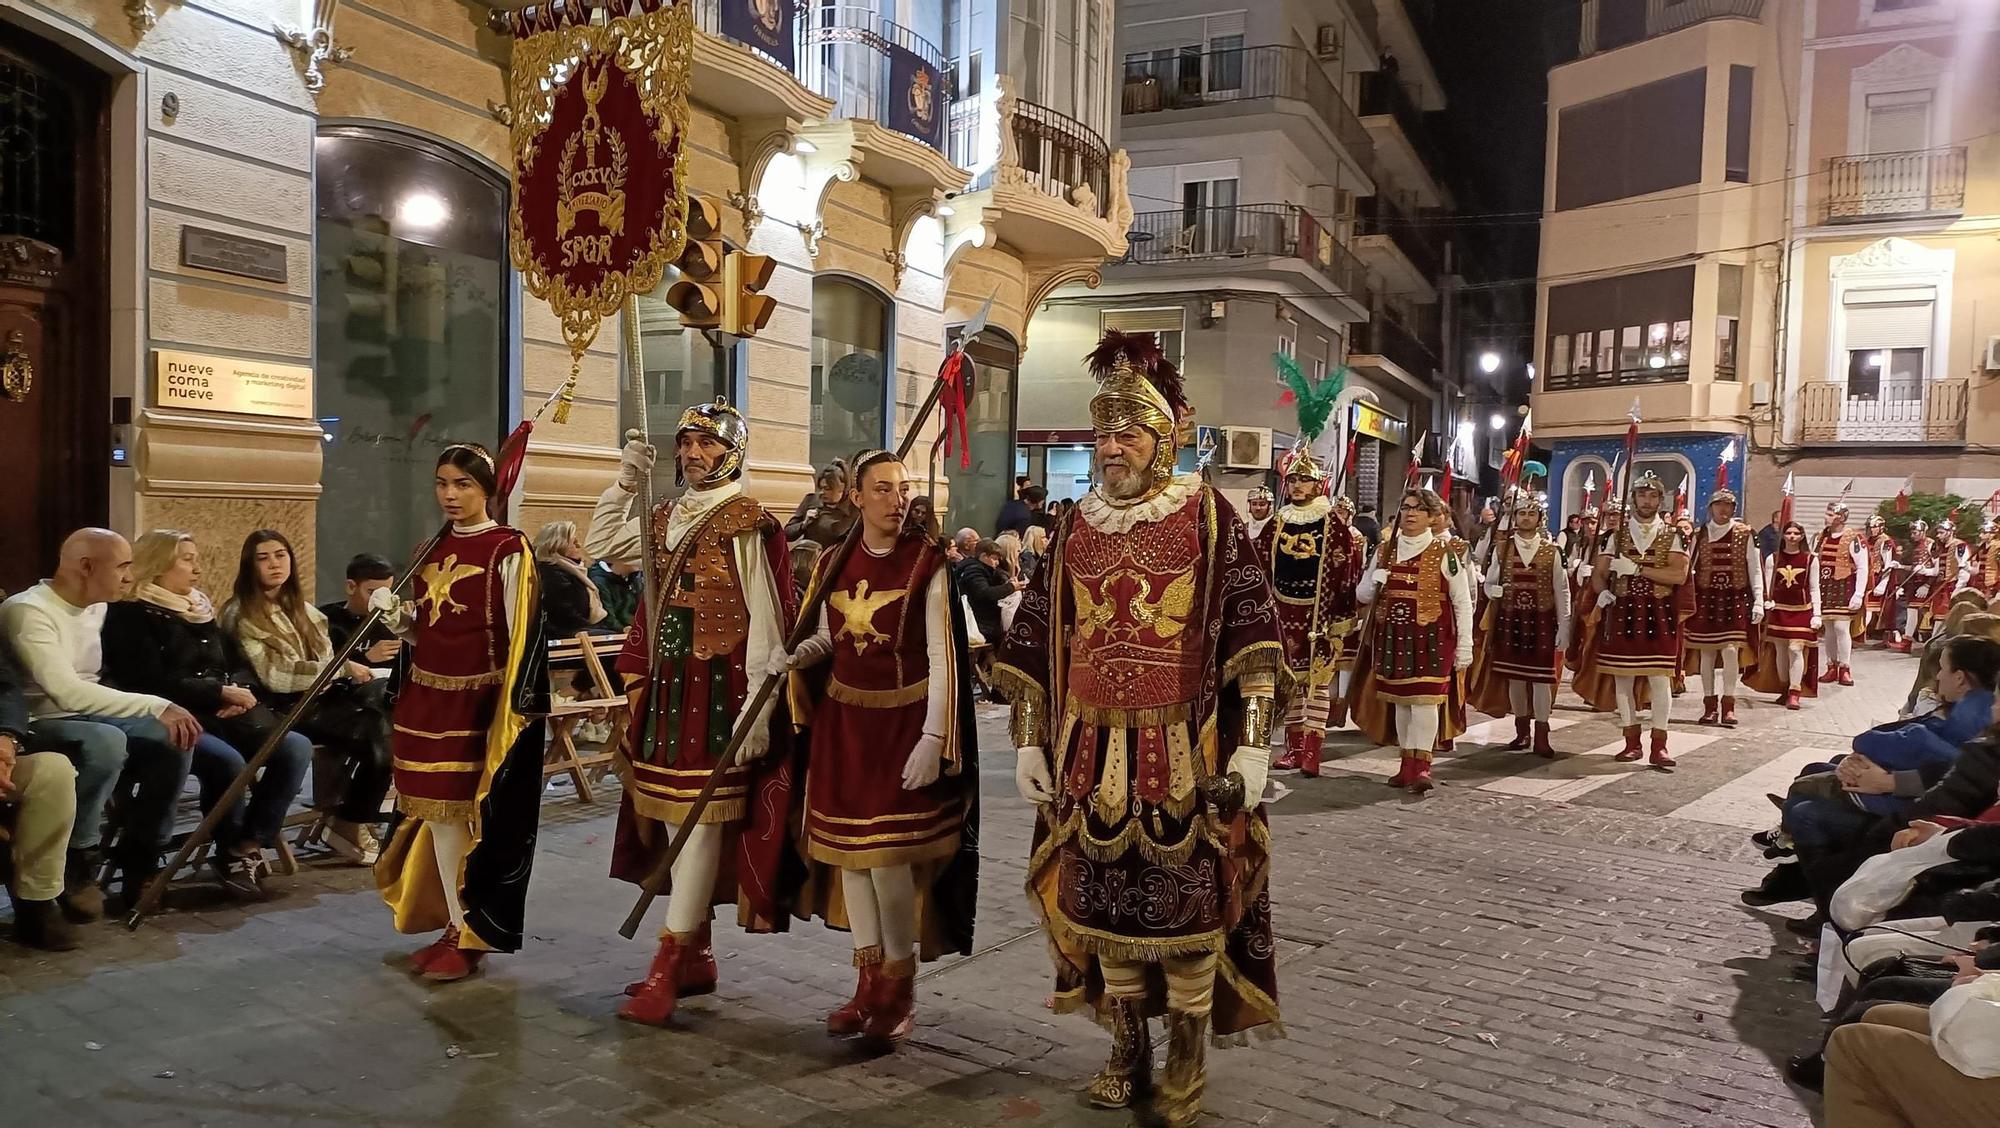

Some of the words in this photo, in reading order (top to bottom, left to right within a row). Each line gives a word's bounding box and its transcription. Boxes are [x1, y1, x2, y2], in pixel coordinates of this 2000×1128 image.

[161, 92, 179, 118] 9
[572, 167, 612, 187] CXXV
[571, 195, 609, 210] NIVERSARIO
[561, 235, 613, 267] SPQR
[168, 362, 214, 376] nueve
[168, 375, 209, 388] coma
[168, 387, 214, 400] nueve
